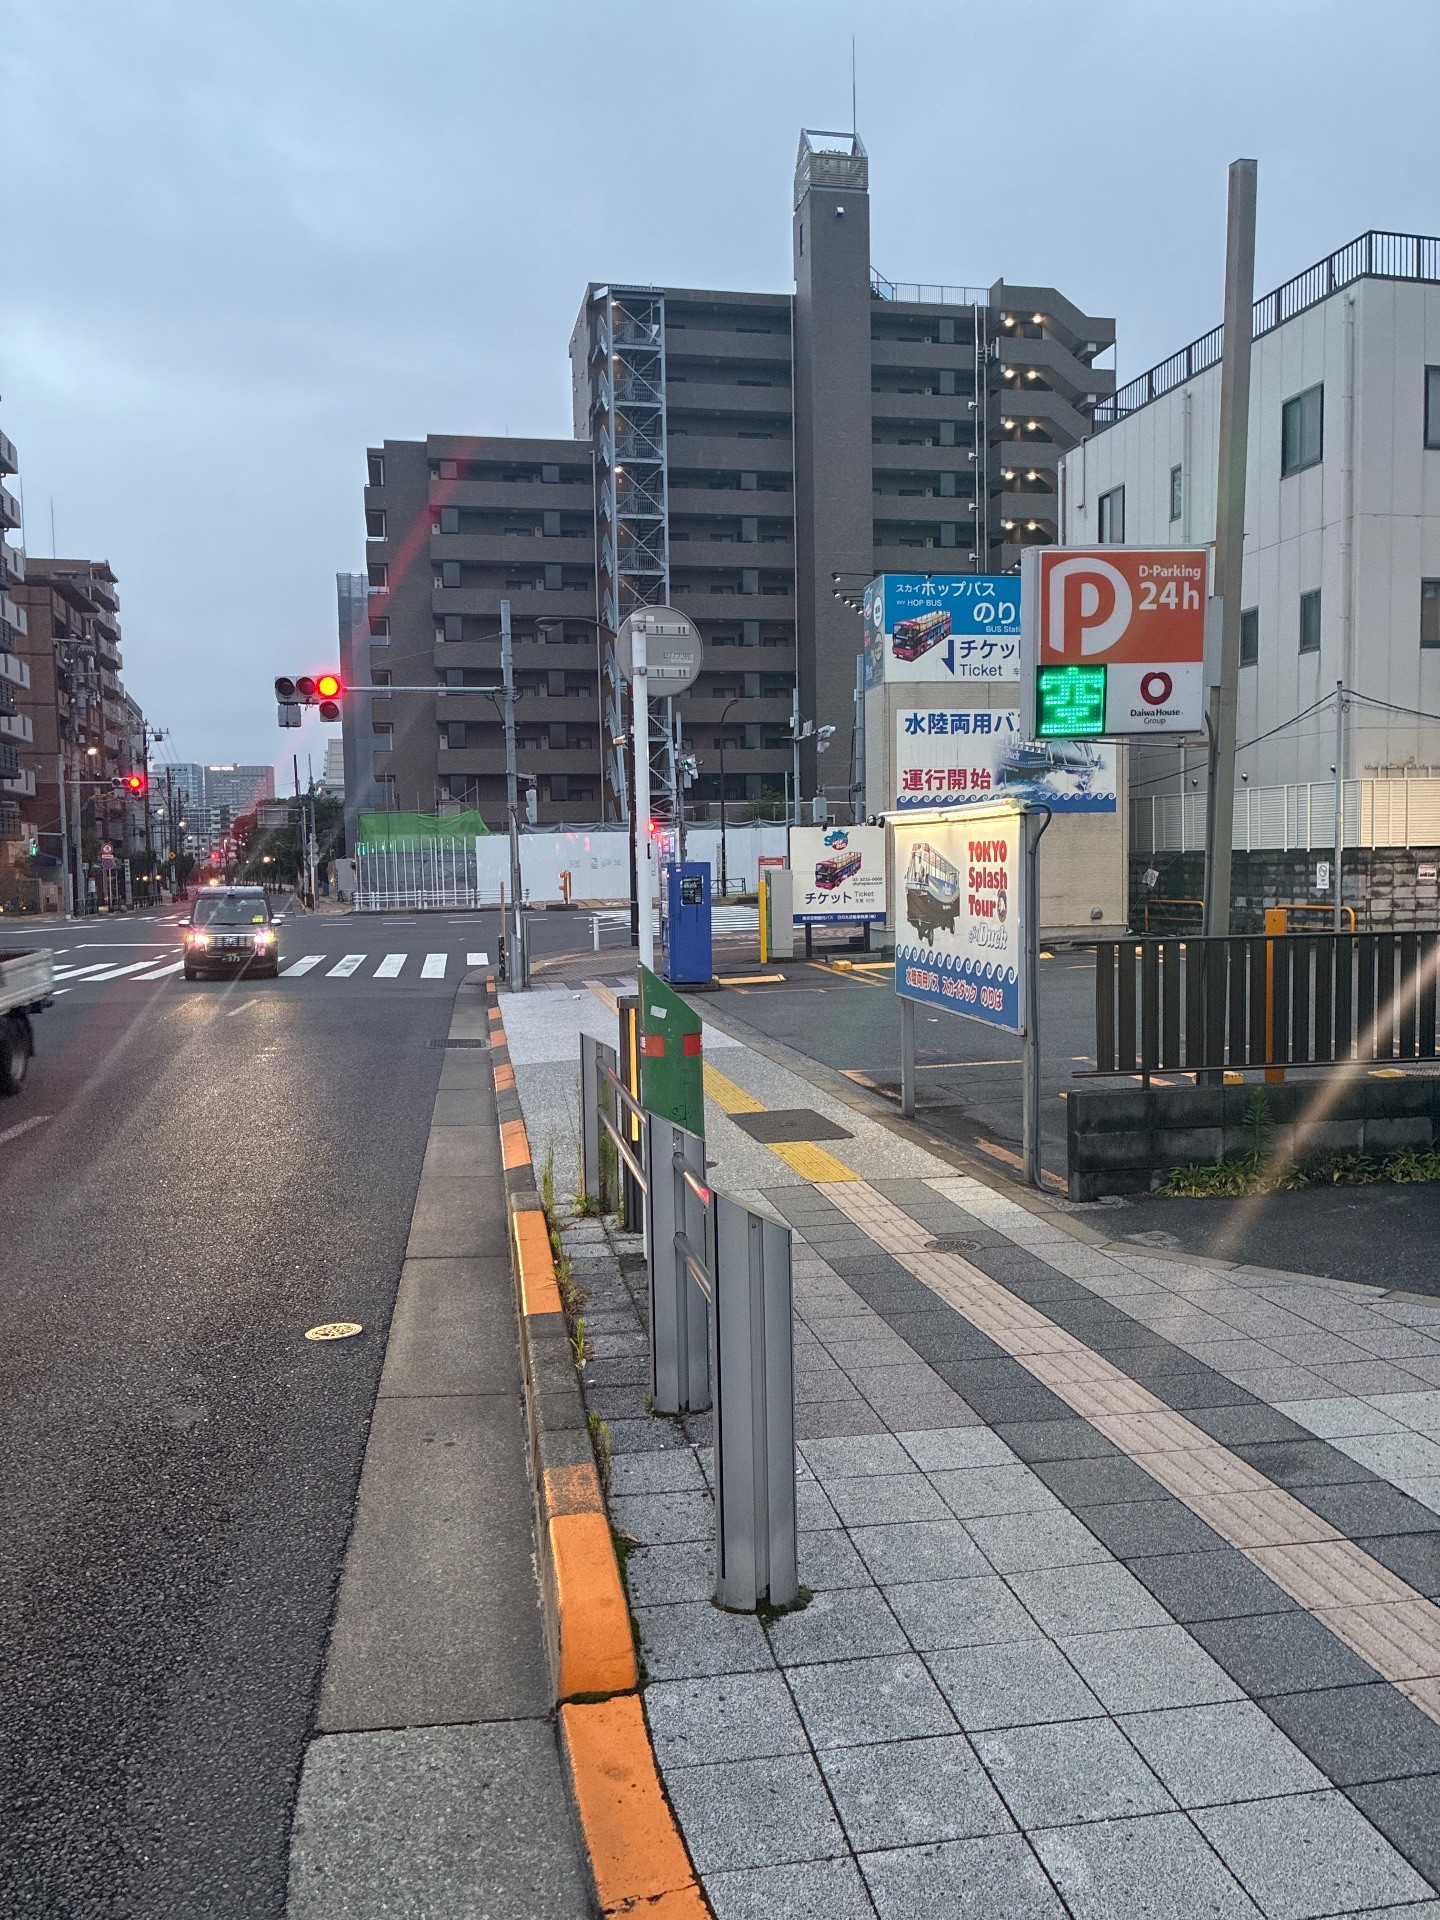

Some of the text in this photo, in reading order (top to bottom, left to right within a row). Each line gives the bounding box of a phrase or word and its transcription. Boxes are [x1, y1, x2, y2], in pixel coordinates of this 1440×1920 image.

[1138, 565, 1201, 580] D-Parking
[896, 580, 996, 597] スカイホップバス
[1138, 581, 1200, 610] 24h
[973, 601, 1021, 624] のり
[959, 639, 1021, 659] チケッ
[959, 663, 1003, 676] Ticket
[904, 711, 1020, 736] 水陸両用バ
[1130, 709, 1154, 717] Daiwa
[902, 768, 992, 791] 運行開始
[968, 840, 1008, 863] TOKYO
[968, 866, 1008, 892] Splash
[804, 891, 852, 905] チケット
[968, 894, 997, 918] Tour
[978, 922, 1008, 950] Duck
[905, 966, 940, 993] 水陸両用バス
[980, 986, 1003, 1011] のりば
